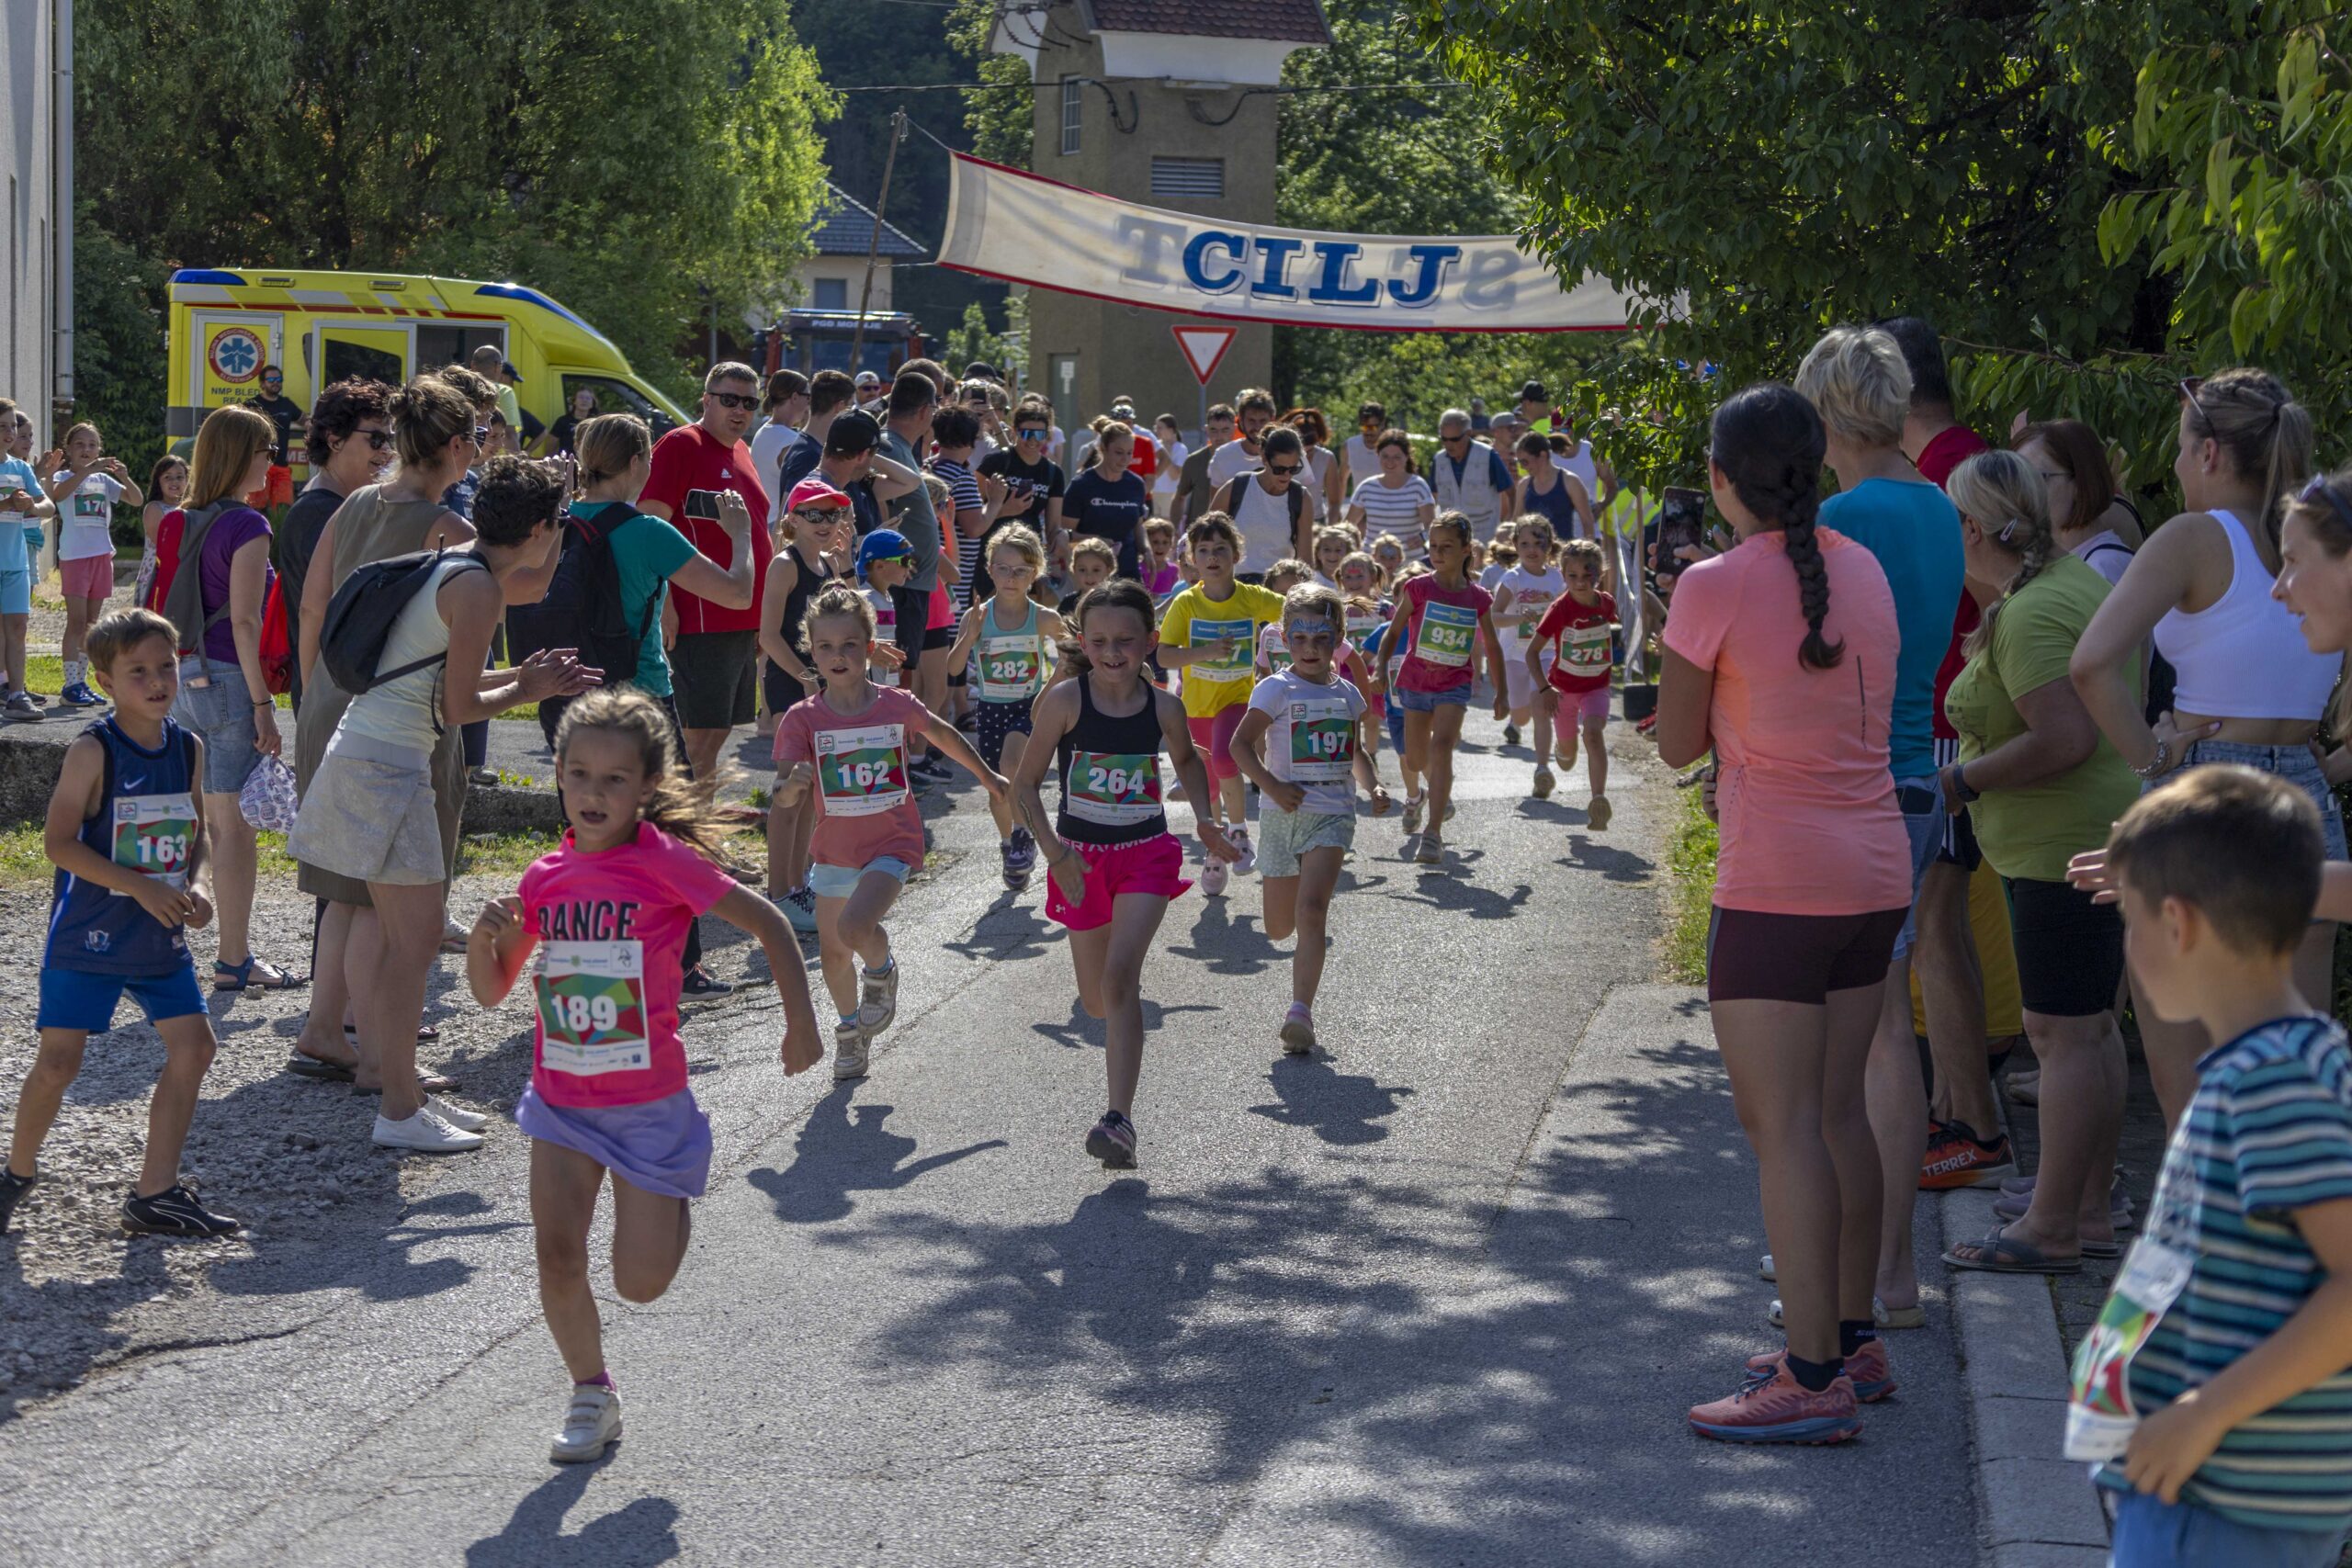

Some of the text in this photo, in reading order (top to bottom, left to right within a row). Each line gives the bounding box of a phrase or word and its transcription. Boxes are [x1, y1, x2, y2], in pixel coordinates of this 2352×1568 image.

[1183, 231, 1463, 308] CILJ
[211, 387, 261, 397] NMP BLED
[1091, 497, 1138, 509] Champion
[1430, 626, 1468, 649] 934
[1571, 646, 1603, 661] 278
[991, 660, 1029, 679] 282
[1308, 731, 1349, 754] 197
[838, 761, 890, 788] 162
[1088, 767, 1146, 795] 264
[137, 833, 187, 863] 163
[551, 994, 618, 1032] 189
[1922, 1148, 1977, 1177] TERREX
